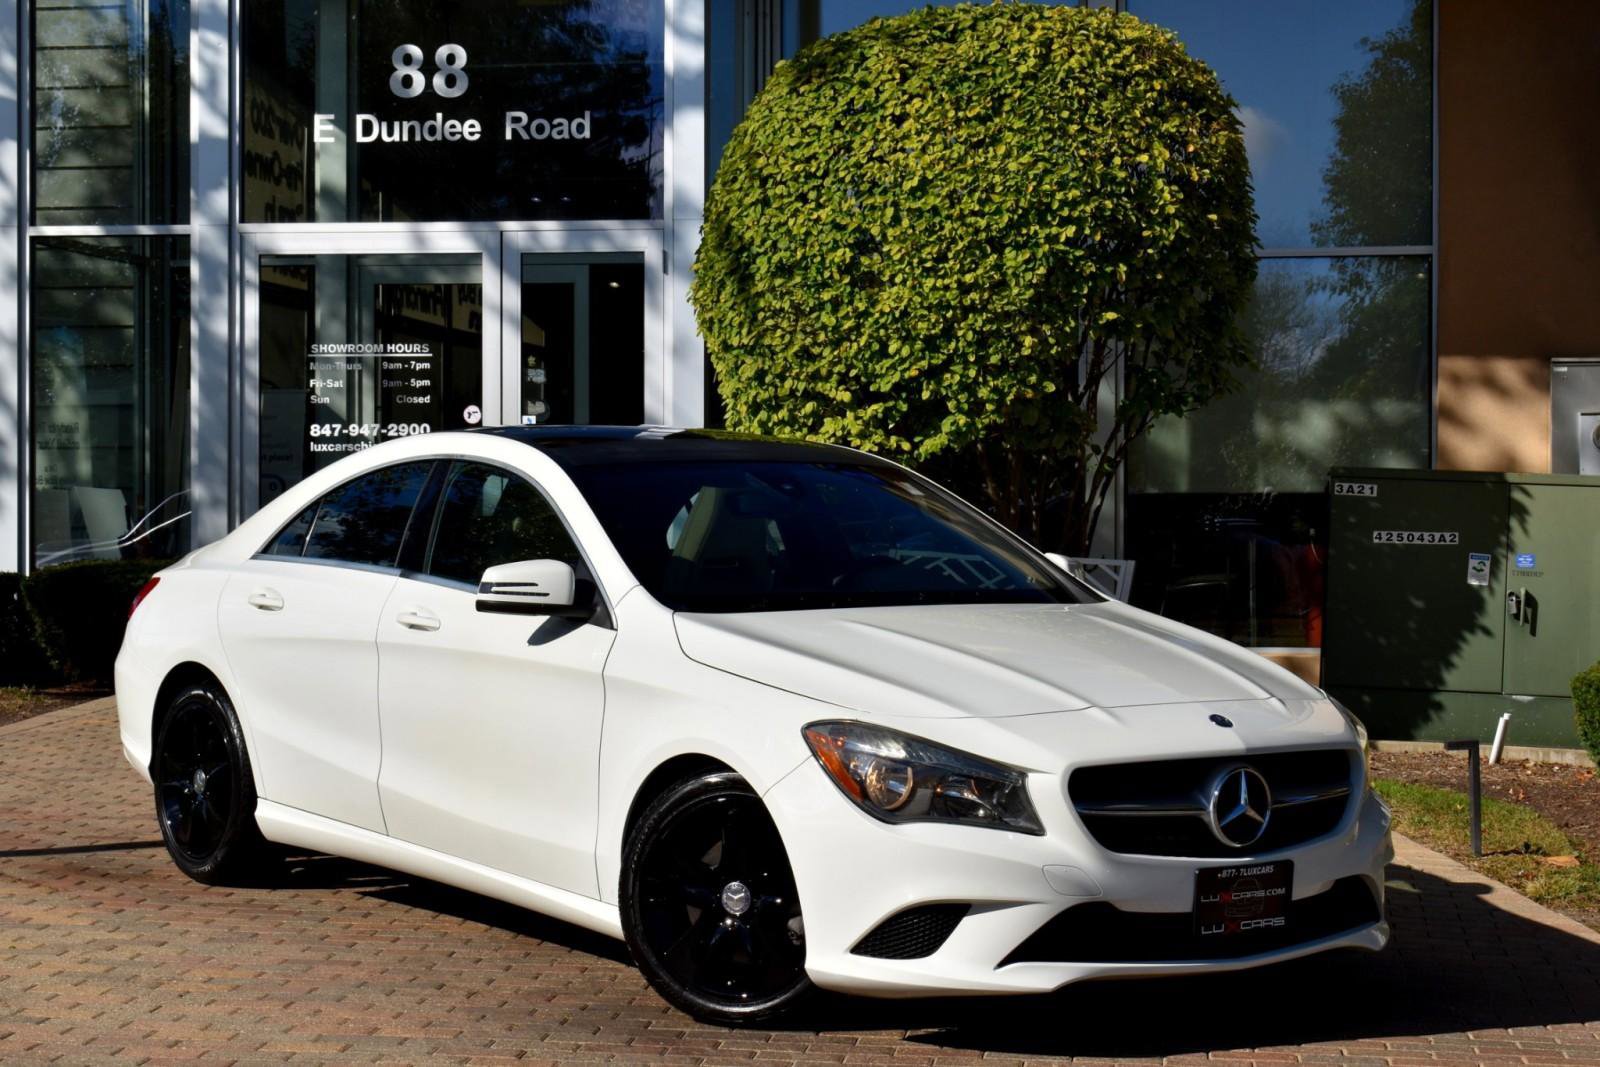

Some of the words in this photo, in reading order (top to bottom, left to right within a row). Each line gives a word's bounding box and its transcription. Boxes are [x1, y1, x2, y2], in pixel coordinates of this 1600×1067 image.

[389, 43, 469, 98] 88
[313, 113, 335, 143] E
[355, 112, 482, 142] Dundee
[504, 110, 591, 141] Road
[311, 343, 384, 354] SHOWROOM
[386, 343, 430, 353] HOURS
[309, 361, 363, 371] Mon-Thurs
[382, 361, 402, 370] 9am
[410, 361, 431, 371] 7pm
[309, 379, 344, 388] Fri-Sat
[382, 379, 402, 388] 9am
[410, 379, 431, 388] 5pm
[310, 395, 330, 404] Sun
[396, 395, 431, 404] Closed
[310, 423, 431, 437] 847-947-2900
[309, 441, 374, 452] luxcarschi
[1335, 483, 1376, 496] 3A21
[1374, 531, 1458, 544] 425043A2
